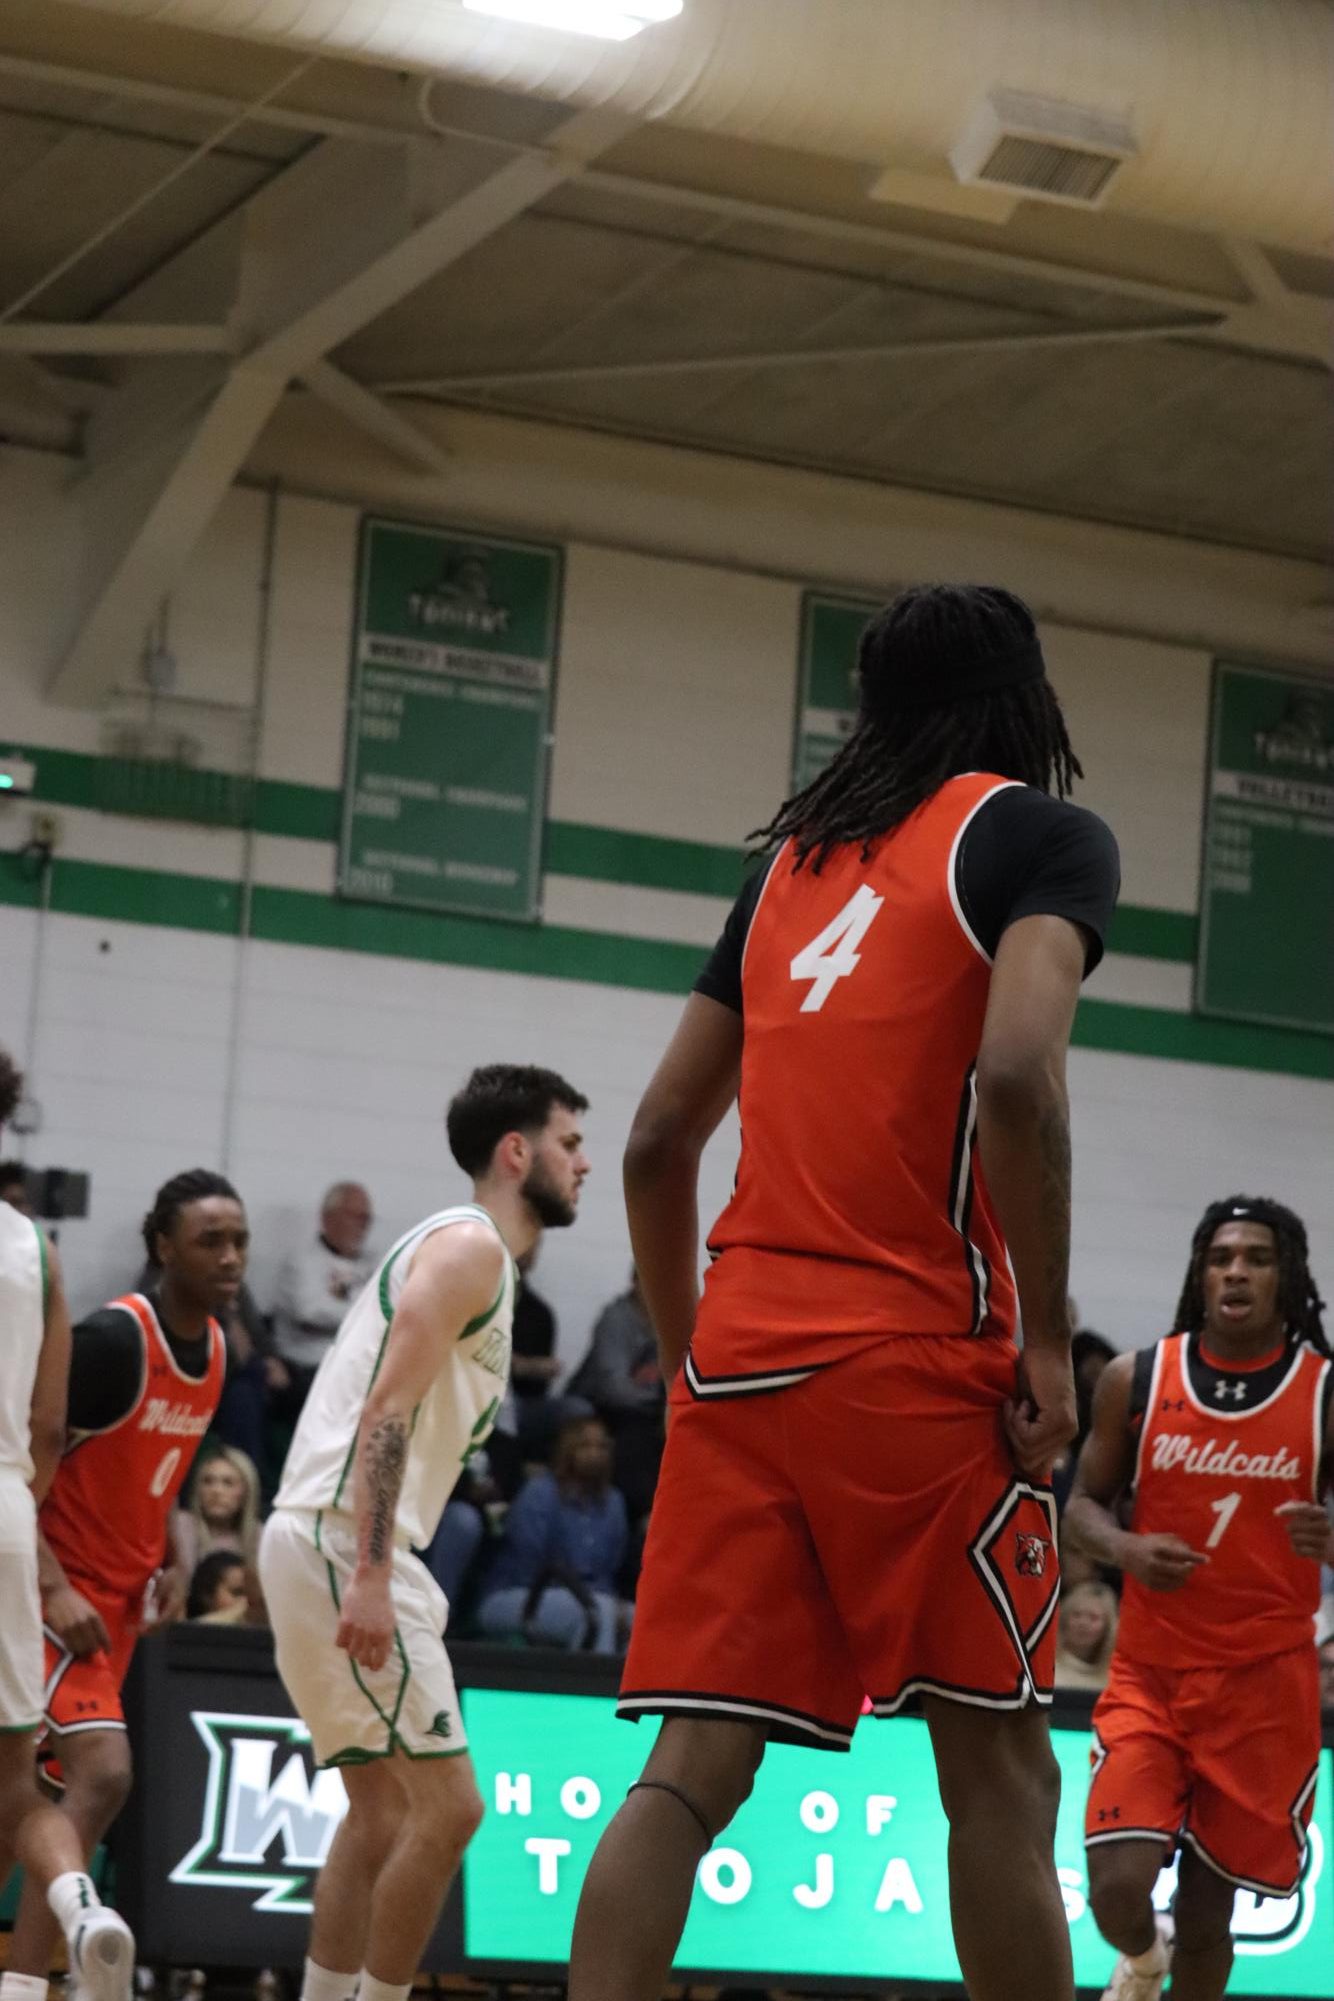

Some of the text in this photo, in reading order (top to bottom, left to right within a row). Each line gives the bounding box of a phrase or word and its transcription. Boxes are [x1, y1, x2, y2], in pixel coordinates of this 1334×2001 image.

[790, 883, 885, 1012] 4
[151, 1447, 181, 1497] 0
[1152, 1433, 1301, 1480] Wildcats
[1210, 1492, 1242, 1548] 1
[494, 1770, 898, 1837] HO OF
[524, 1836, 1087, 1924] TOJAS
